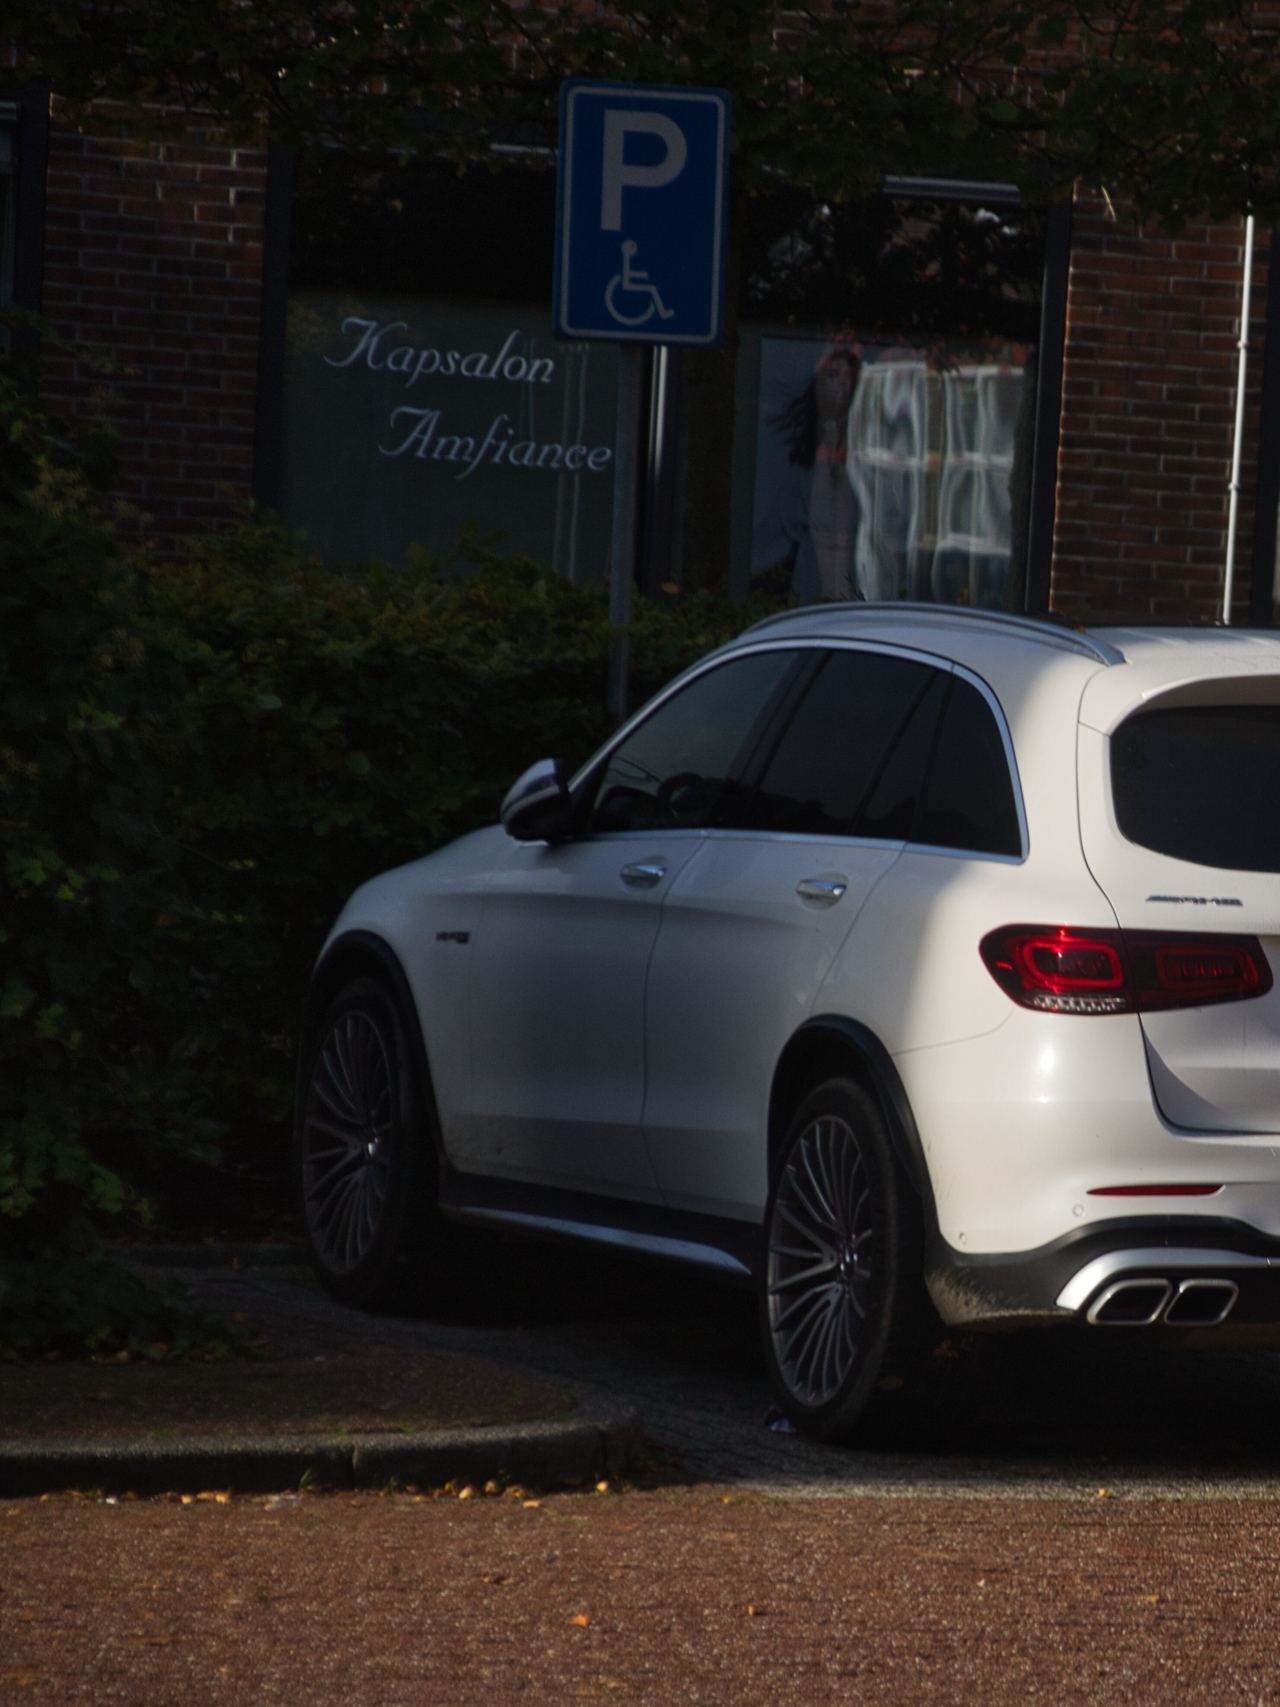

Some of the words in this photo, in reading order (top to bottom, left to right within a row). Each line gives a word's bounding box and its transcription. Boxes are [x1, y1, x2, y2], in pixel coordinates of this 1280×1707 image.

[601, 109, 688, 231] P
[323, 316, 554, 389] Kapsalon
[378, 406, 612, 480] Amfiance
